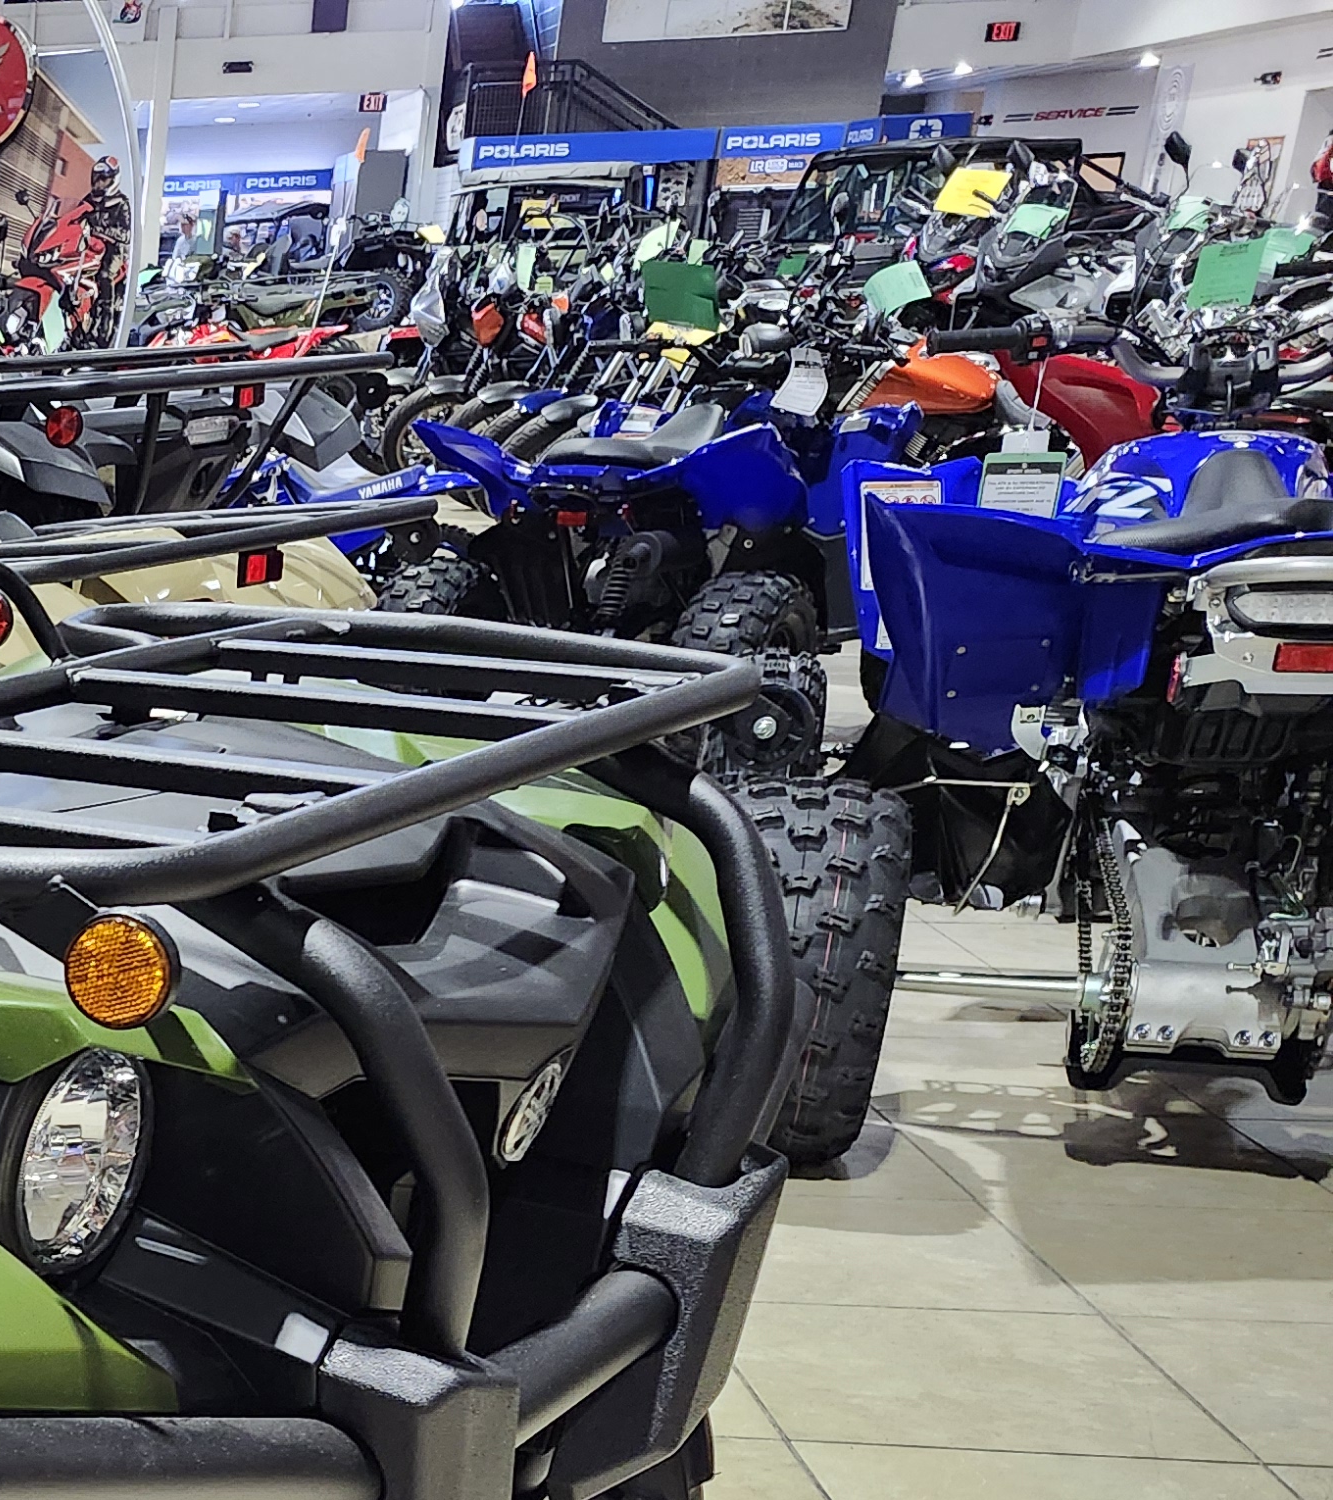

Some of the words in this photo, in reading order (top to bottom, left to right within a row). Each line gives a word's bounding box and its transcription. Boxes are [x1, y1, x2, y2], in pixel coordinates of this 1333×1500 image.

[992, 23, 1016, 40] EXIT
[363, 95, 383, 111] EXIT
[1033, 107, 1107, 122] SERVICE
[726, 133, 821, 150] POLARIS
[479, 143, 570, 159] POLARIS
[164, 180, 221, 192] OLARIS
[246, 175, 317, 189] POLARIS
[358, 475, 403, 499] YAMAHA
